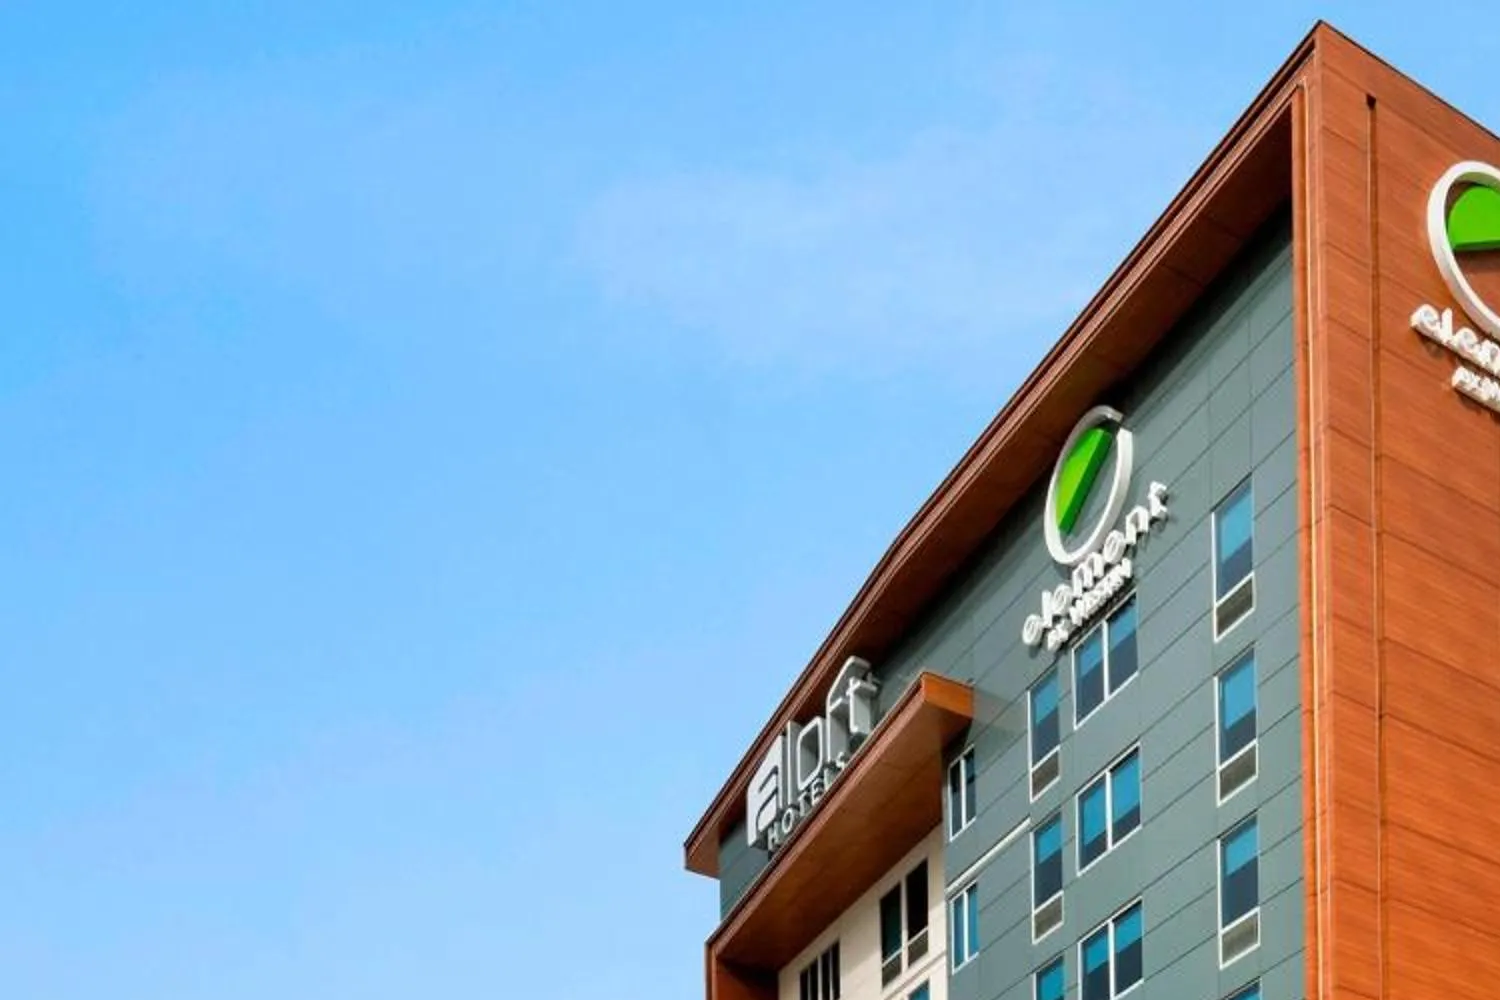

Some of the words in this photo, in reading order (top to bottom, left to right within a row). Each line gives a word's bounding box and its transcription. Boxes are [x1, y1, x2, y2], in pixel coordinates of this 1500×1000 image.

[1022, 481, 1169, 646] element
[747, 655, 879, 846] aloft
[768, 751, 851, 851] HOTELS
